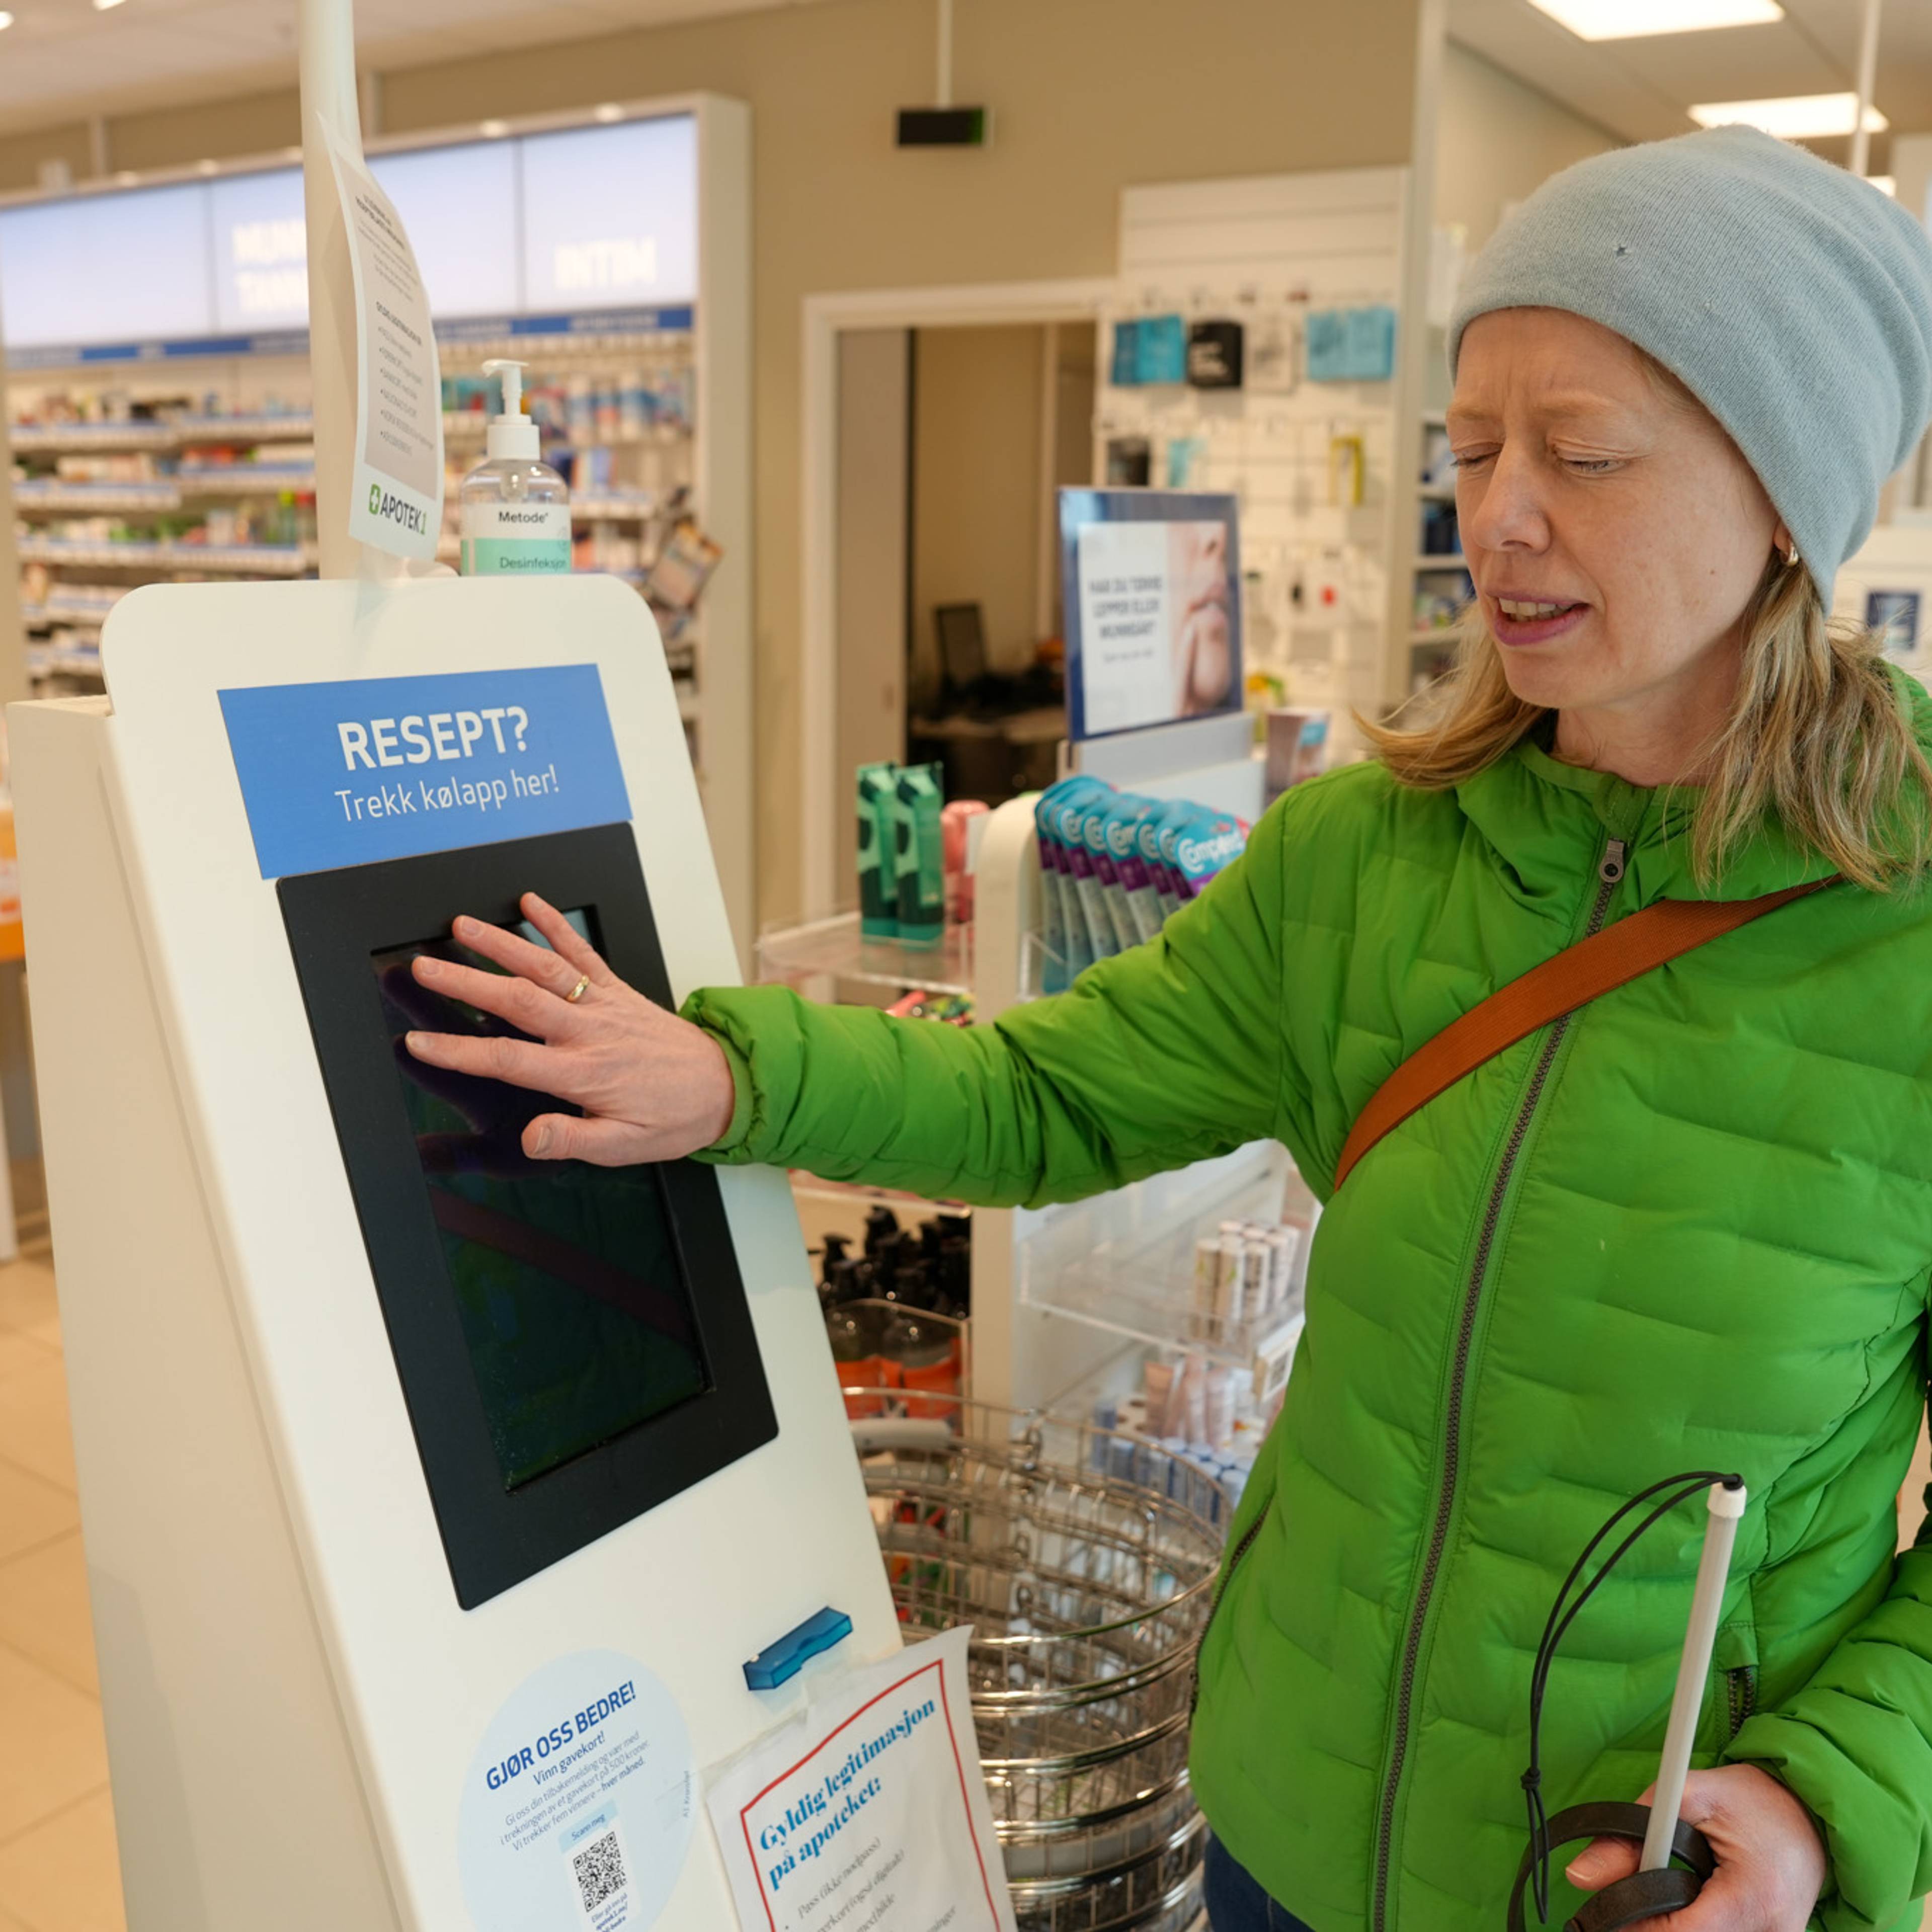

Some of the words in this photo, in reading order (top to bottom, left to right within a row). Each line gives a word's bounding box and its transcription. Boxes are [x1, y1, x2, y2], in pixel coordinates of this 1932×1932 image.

[337, 706, 528, 771] RESEPT?
[334, 783, 417, 822] Trekk
[420, 776, 508, 812] kølapp
[511, 764, 559, 797] her!
[486, 1747, 535, 1790] GJØR
[536, 1721, 573, 1758] OSS
[575, 1680, 636, 1734] BEDRE!
[533, 1764, 558, 1785] Vinn
[559, 1730, 605, 1774] gavekort!
[760, 1788, 827, 1850] Gyldig
[825, 1700, 935, 1798] legitimasjon
[505, 1813, 516, 1826] Gi
[516, 1806, 530, 1820] oss
[530, 1798, 543, 1810] din
[543, 1760, 598, 1801] tilbakemelding
[599, 1753, 609, 1764] og
[624, 1730, 639, 1747] med
[506, 1809, 547, 1842] trekningen
[548, 1805, 555, 1815] av
[557, 1796, 566, 1807] et
[567, 1774, 599, 1804] gavekort
[600, 1766, 609, 1781] på
[609, 1755, 625, 1772] 500
[512, 1837, 523, 1851] Vi
[523, 1820, 551, 1845] trekker
[552, 1810, 569, 1825] fem
[568, 1792, 596, 1814] vinnere
[601, 1775, 618, 1791] hver
[769, 1849, 796, 1891] på
[799, 1778, 881, 1862] apoteket:
[798, 1895, 820, 1919] Pass
